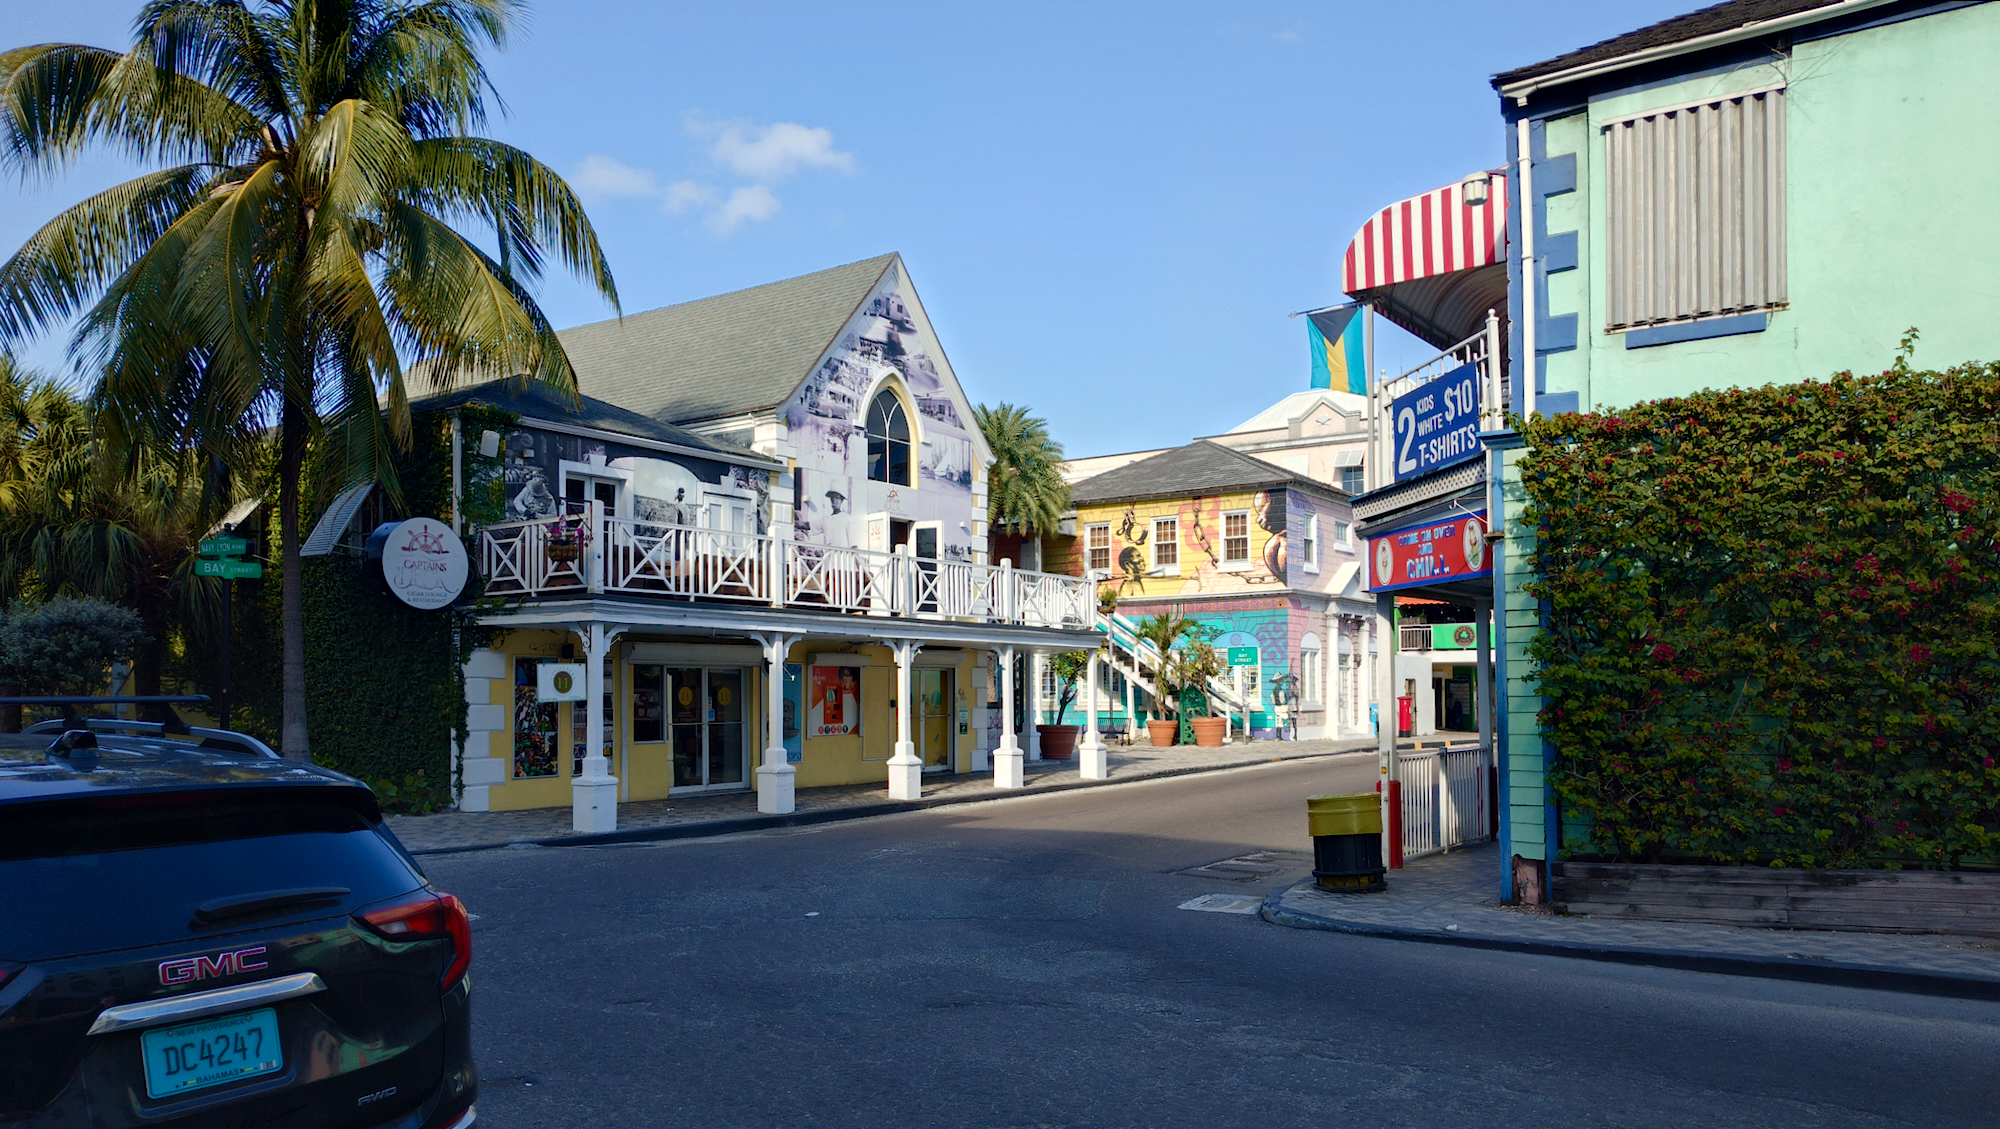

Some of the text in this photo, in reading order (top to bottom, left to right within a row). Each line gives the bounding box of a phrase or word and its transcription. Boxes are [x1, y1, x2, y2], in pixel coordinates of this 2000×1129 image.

[1416, 394, 1434, 415] KIDS
[1444, 379, 1473, 425] $10
[1417, 413, 1443, 437] WHITE
[1397, 406, 1417, 474] 2
[1418, 423, 1476, 467] T-SHIRTS
[1398, 524, 1455, 547] COME ON OVER
[1418, 542, 1433, 555] AND
[204, 562, 226, 573] BAY
[404, 560, 447, 571] CAPTAINS
[1406, 554, 1450, 579] CHILL
[158, 946, 268, 985] GMC
[176, 1018, 246, 1037] NEW PROVIDENCE
[162, 1027, 263, 1076] DC4247
[196, 1068, 240, 1084] BAHAMAS
